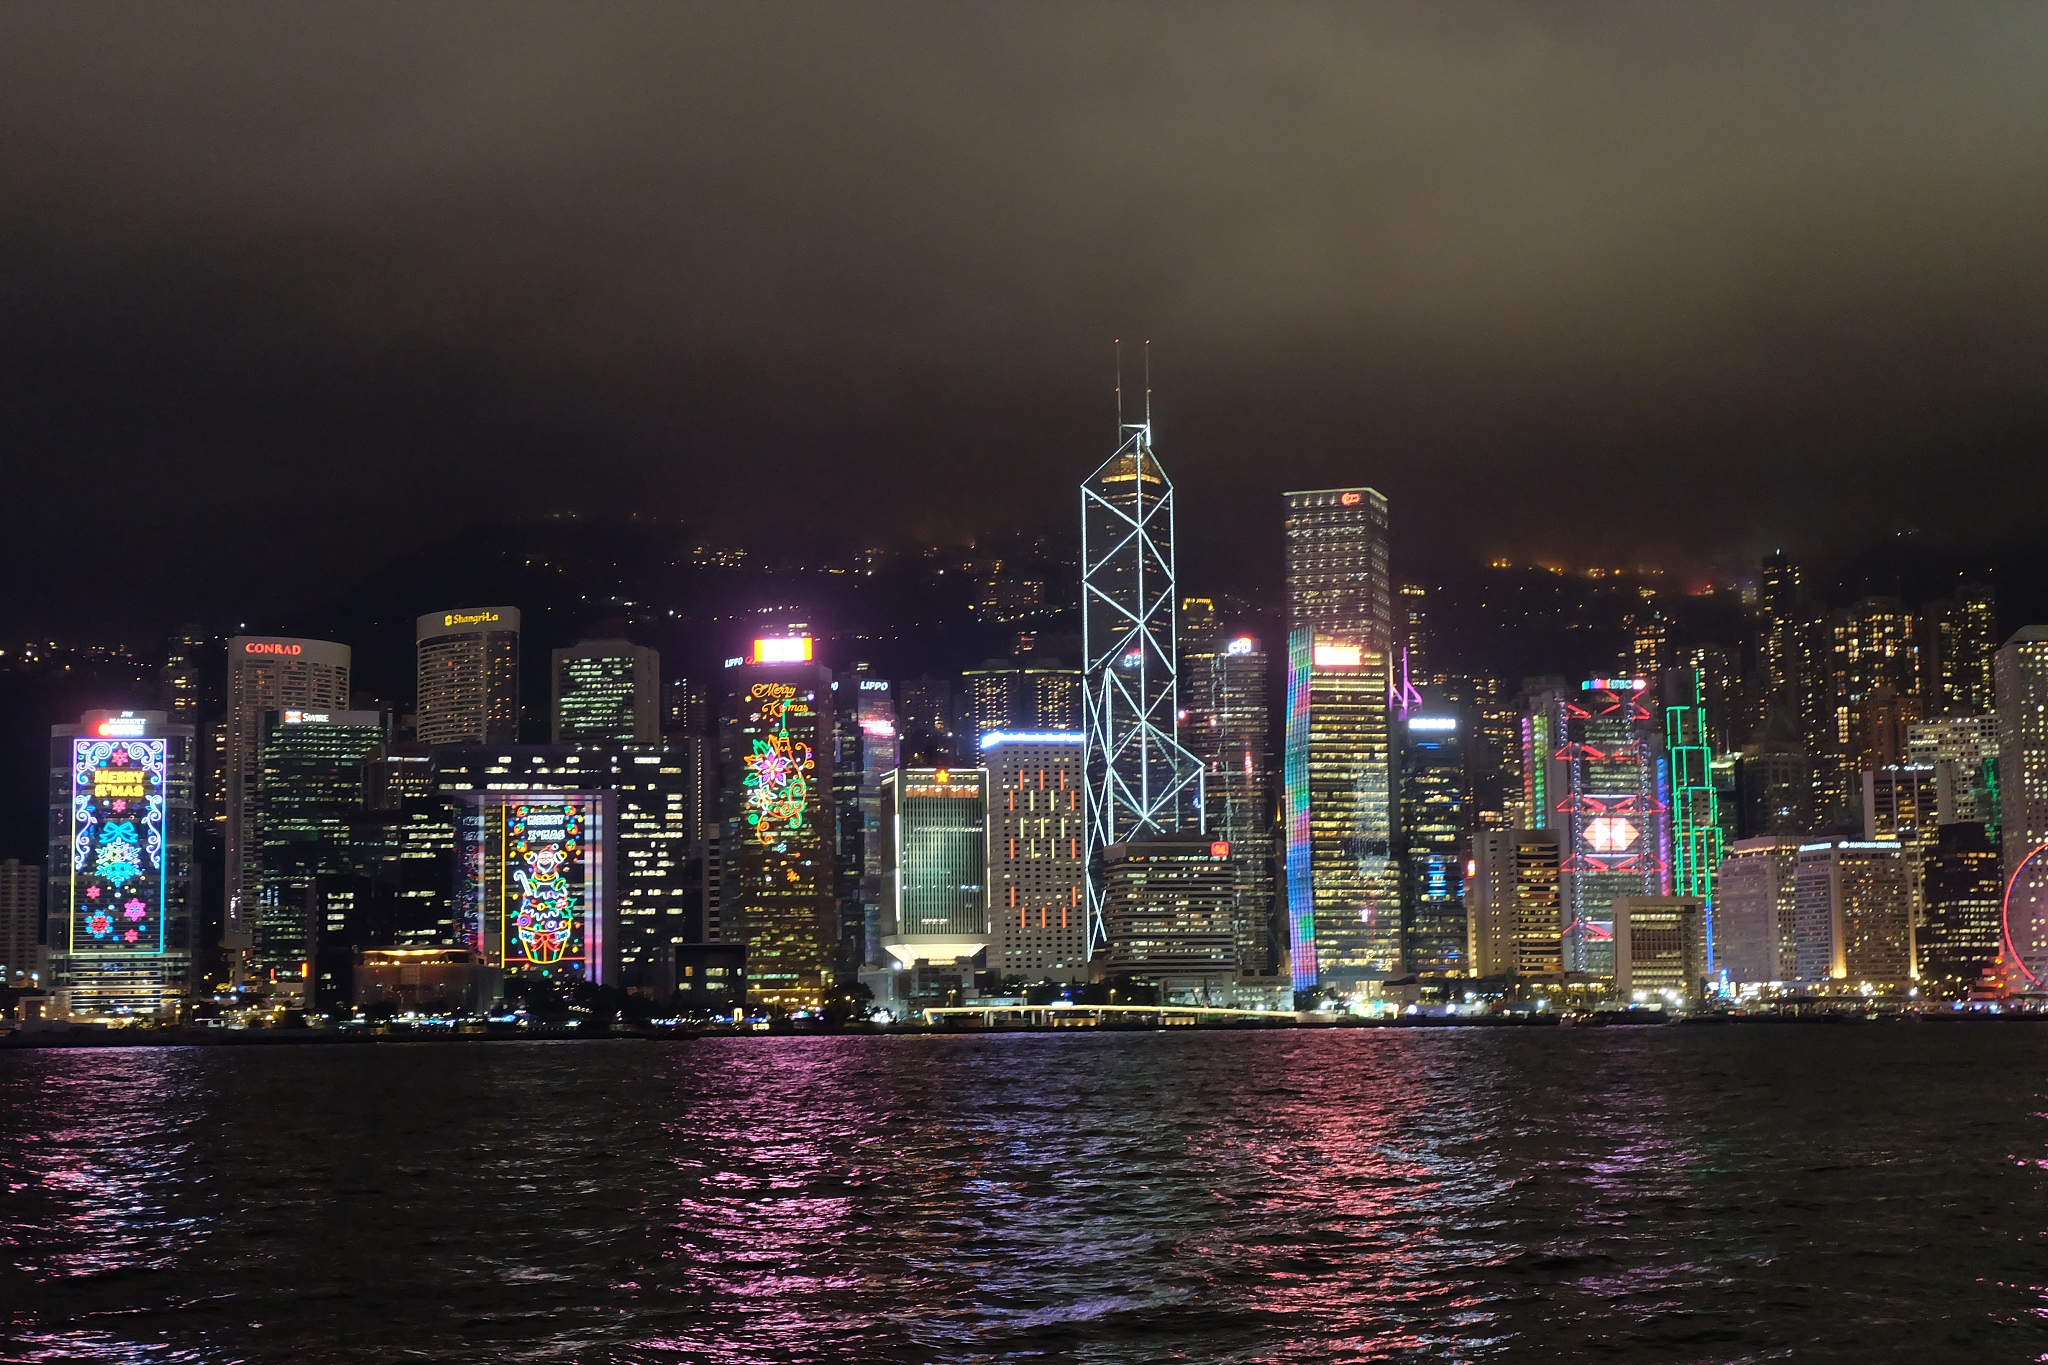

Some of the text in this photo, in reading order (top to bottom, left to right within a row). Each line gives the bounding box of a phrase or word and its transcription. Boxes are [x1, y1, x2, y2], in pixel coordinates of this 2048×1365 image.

[245, 643, 303, 656] CONRAD
[724, 657, 743, 668] LIPPO
[751, 683, 797, 699] Merry
[860, 681, 889, 691] LIPPO
[94, 770, 145, 784] MERRY
[527, 814, 565, 825] MERRY
